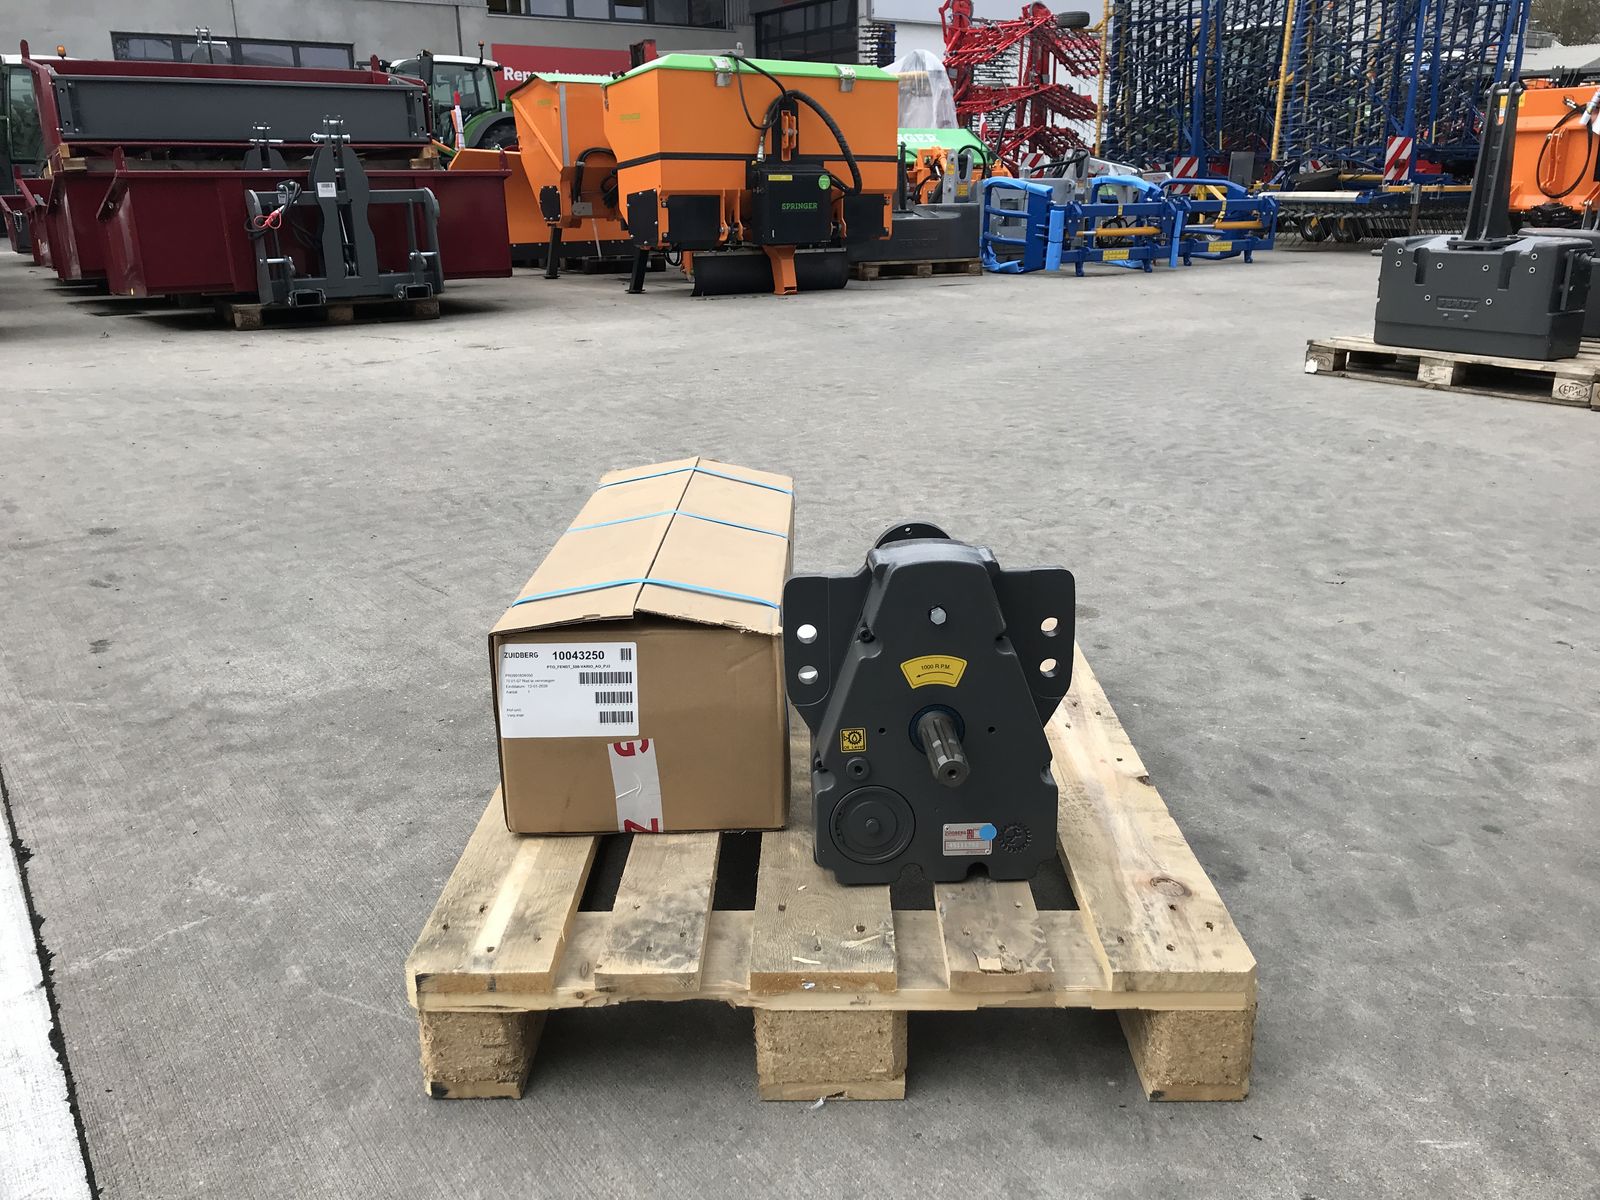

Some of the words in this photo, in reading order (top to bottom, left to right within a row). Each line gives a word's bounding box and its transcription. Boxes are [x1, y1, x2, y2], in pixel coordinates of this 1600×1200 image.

[781, 202, 818, 210] SPRINGER
[503, 651, 539, 659] ZUIDBERG
[552, 650, 605, 661] 10043250
